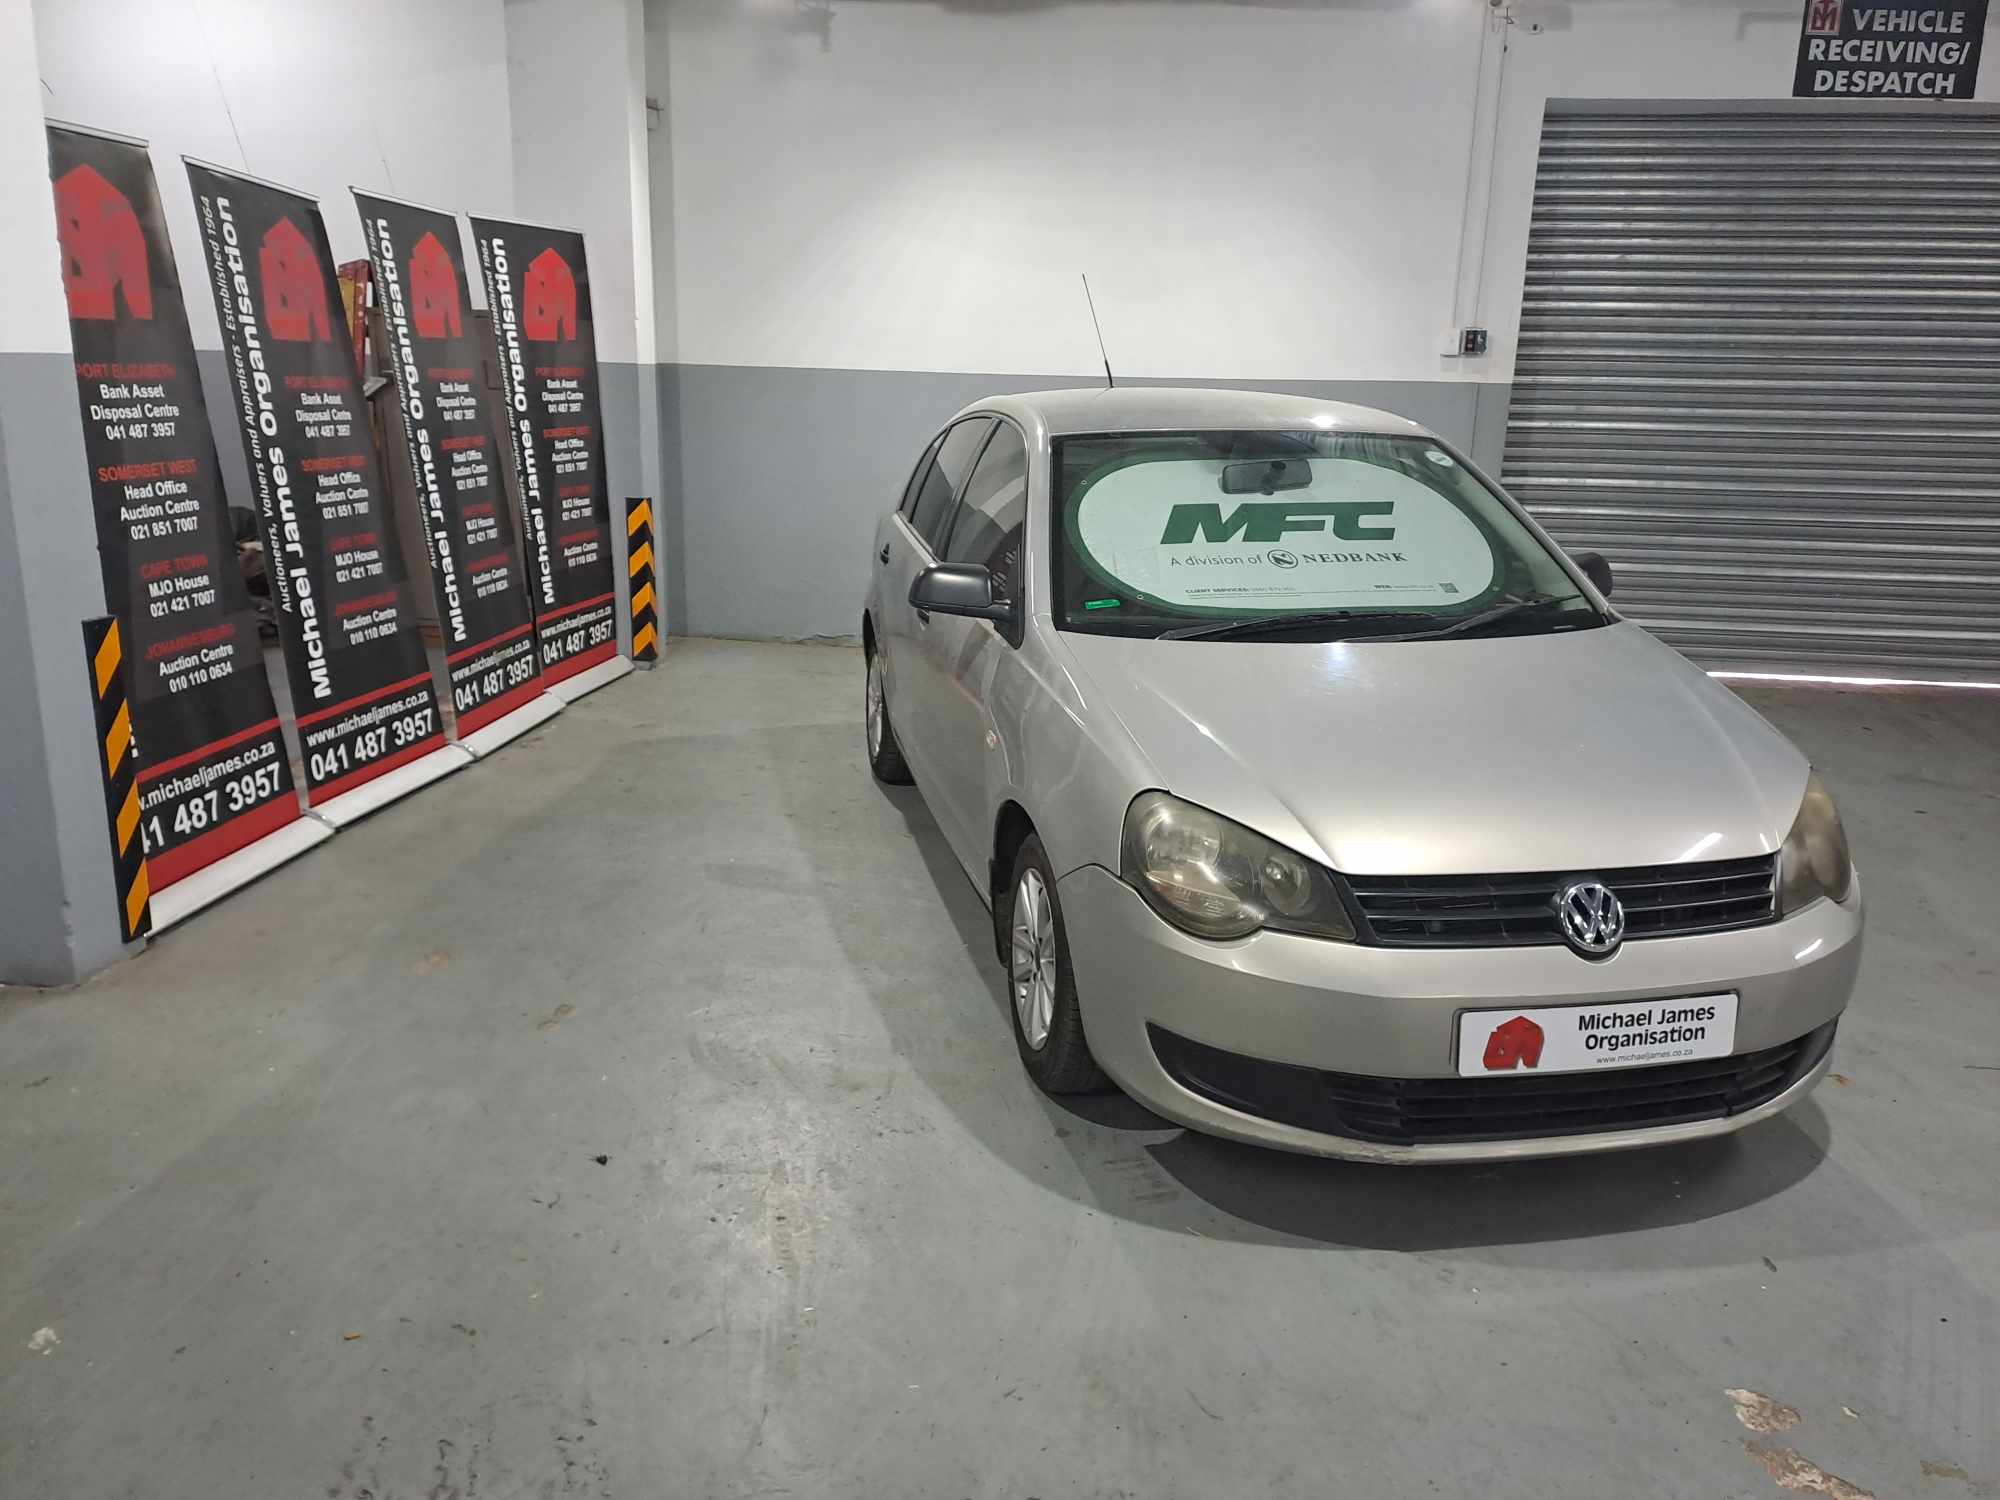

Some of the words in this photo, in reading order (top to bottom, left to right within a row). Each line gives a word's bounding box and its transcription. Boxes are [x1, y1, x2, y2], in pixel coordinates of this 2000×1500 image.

[1852, 9, 1965, 34] VEHICLE
[1808, 39, 1971, 65] RECEIVING/
[1813, 69, 1956, 95] DESPATCH
[209, 240, 236, 330] Established
[99, 384, 131, 399] Bank
[132, 384, 166, 398] Asset
[230, 343, 255, 426] Appraisers
[300, 393, 322, 405] Bank
[90, 404, 142, 423] Disposal
[144, 403, 180, 418] Centre
[296, 410, 331, 424] Disposal
[105, 425, 127, 440] 041
[129, 424, 148, 438] 487
[150, 422, 175, 437] 3957
[247, 429, 261, 458] and
[520, 419, 541, 501] James
[123, 484, 154, 500] Head
[155, 480, 188, 496] Office
[256, 463, 273, 516] Valuers
[318, 473, 338, 487] Head
[417, 428, 444, 523] James
[120, 504, 164, 522] Auction
[165, 499, 200, 515] Centre
[268, 447, 304, 558] James
[315, 490, 346, 504] Auction
[130, 525, 150, 540] 021
[152, 521, 172, 537] 851
[173, 516, 198, 533] 7007
[1160, 501, 1396, 545] MFC
[269, 524, 292, 612] Auctioneers,
[531, 508, 555, 605] Michael
[1171, 557, 1181, 567] A
[1184, 555, 1243, 567] division
[1247, 554, 1263, 565] of
[1301, 552, 1409, 564] NEDBANK
[148, 579, 173, 598] MJO
[174, 575, 209, 592] House
[434, 530, 467, 642] Michael
[150, 601, 169, 618] 021
[170, 595, 190, 612] 421
[191, 589, 215, 607] 7007
[290, 567, 332, 699] Michael
[343, 615, 372, 631] Auction
[542, 639, 563, 664] 041
[566, 629, 585, 654] 487
[589, 620, 613, 645] 3957
[159, 654, 199, 677] Auction
[200, 644, 234, 663] Centre
[169, 676, 188, 693] 010
[188, 669, 208, 686] 110
[209, 661, 233, 680] 0634
[455, 682, 480, 711] 041
[483, 670, 504, 696] 487
[507, 654, 534, 685] 3957
[306, 690, 429, 747] www.michaeljames.co.za
[310, 742, 349, 780] 041
[354, 727, 387, 760] 487
[392, 708, 432, 746] 3957
[173, 790, 219, 834] 487
[225, 761, 281, 811] 3957
[1579, 1009, 1652, 1031] Michael
[1657, 1006, 1715, 1025] James
[1585, 1026, 1706, 1051] Organisation
[1597, 1048, 1694, 1064] www.michaeljames.co.za
